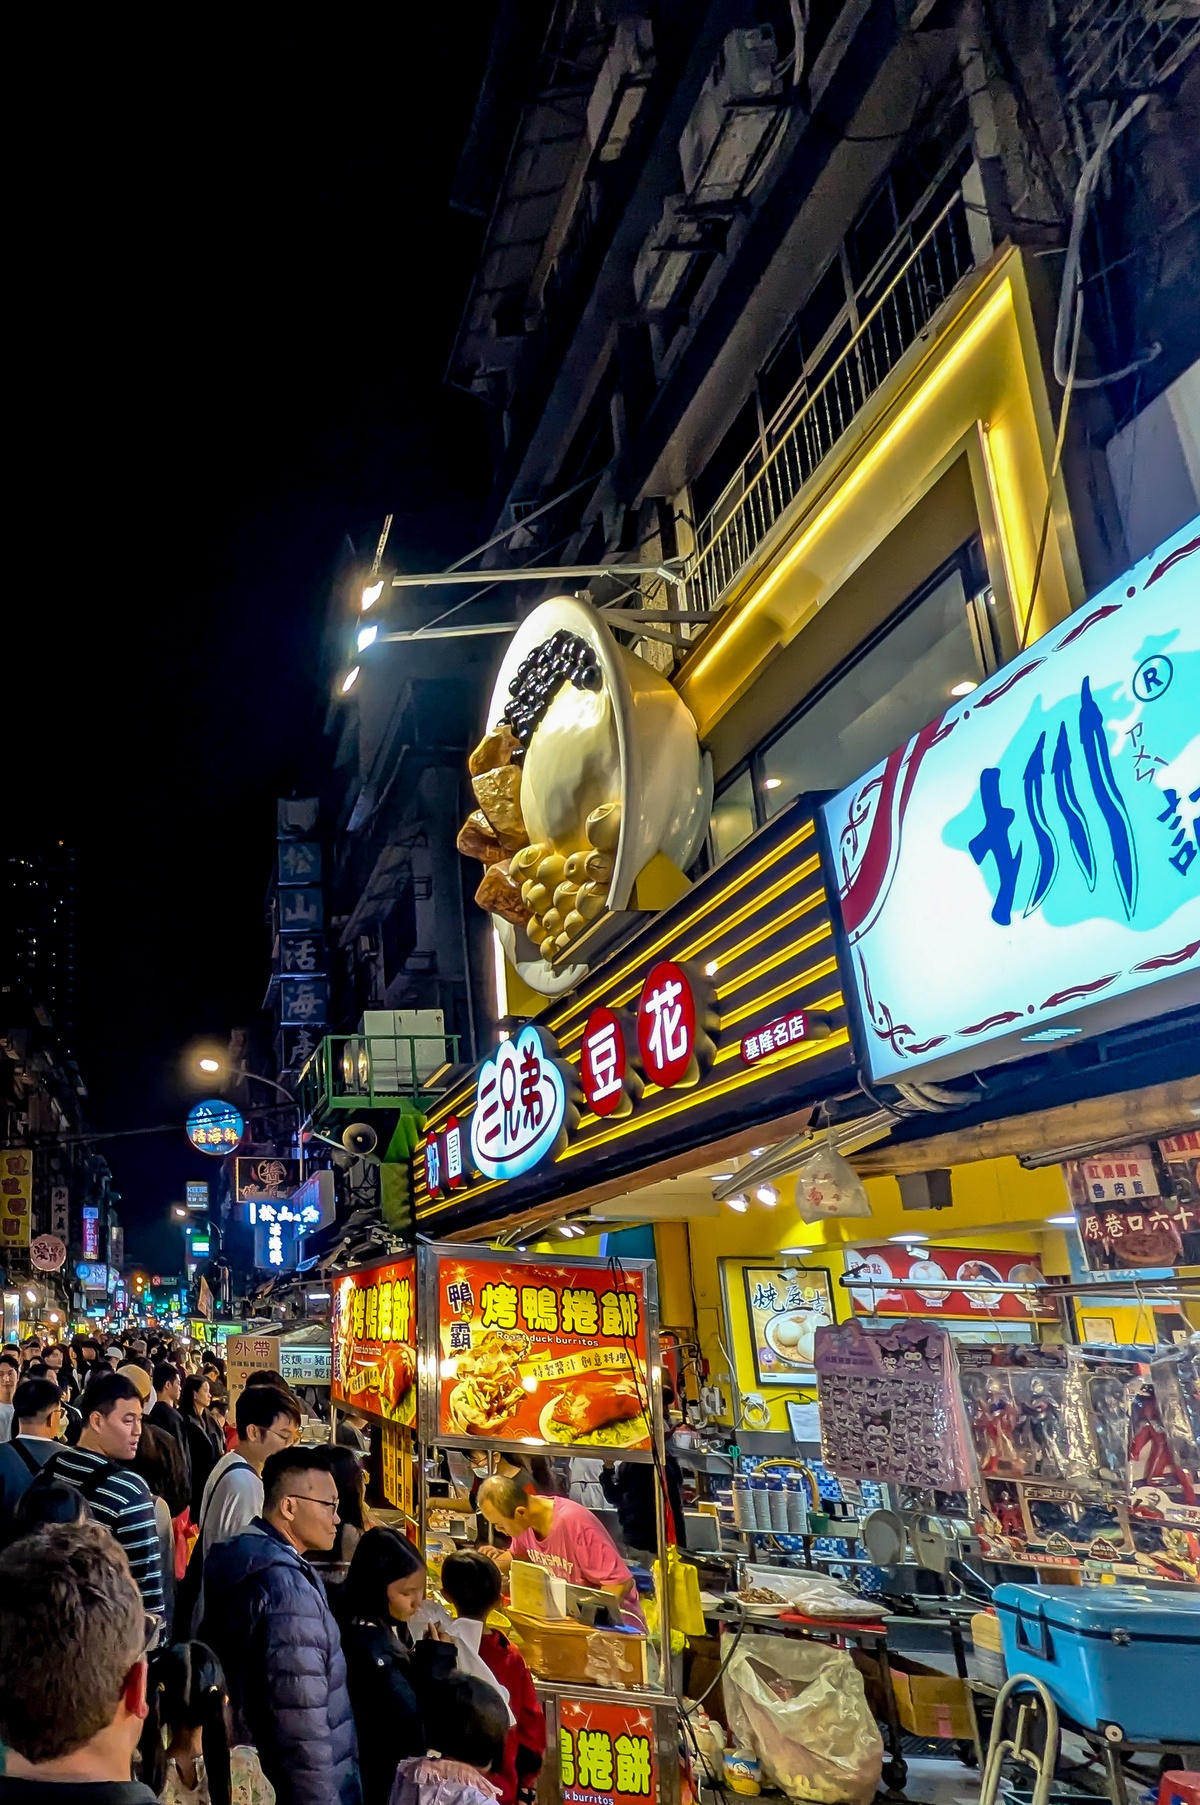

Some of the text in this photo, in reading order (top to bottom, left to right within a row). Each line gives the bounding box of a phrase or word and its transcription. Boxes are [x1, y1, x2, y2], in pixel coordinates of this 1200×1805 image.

[587, 981, 689, 1102] 豆花
[744, 1014, 805, 1060] 基隆名店
[1084, 1206, 1195, 1240] 原巷口六十
[447, 1281, 473, 1350] 鴨霸
[481, 1282, 639, 1338] 烤鴨捲餅
[234, 1341, 271, 1357] 外帶
[496, 1331, 599, 1347] Roast duck burritos
[573, 1793, 615, 1805] burritos
